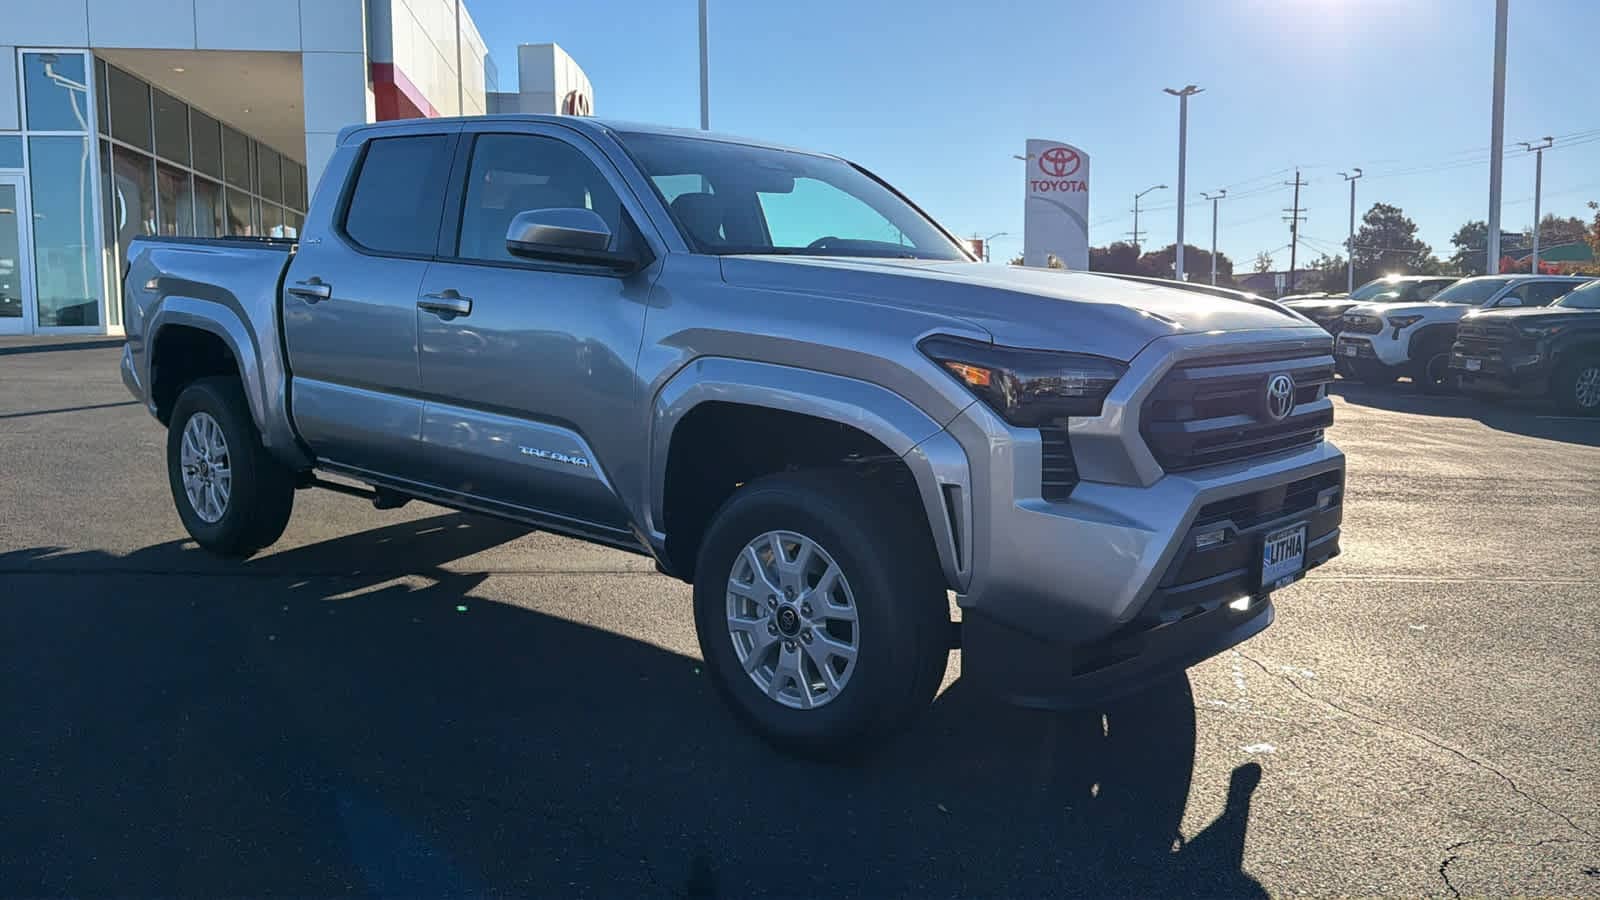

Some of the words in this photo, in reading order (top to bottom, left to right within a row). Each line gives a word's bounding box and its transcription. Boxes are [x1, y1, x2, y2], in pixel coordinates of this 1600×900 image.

[1031, 180, 1087, 192] TOYOTA
[519, 446, 591, 467] TACOMA
[1270, 533, 1303, 565] LITHIA
